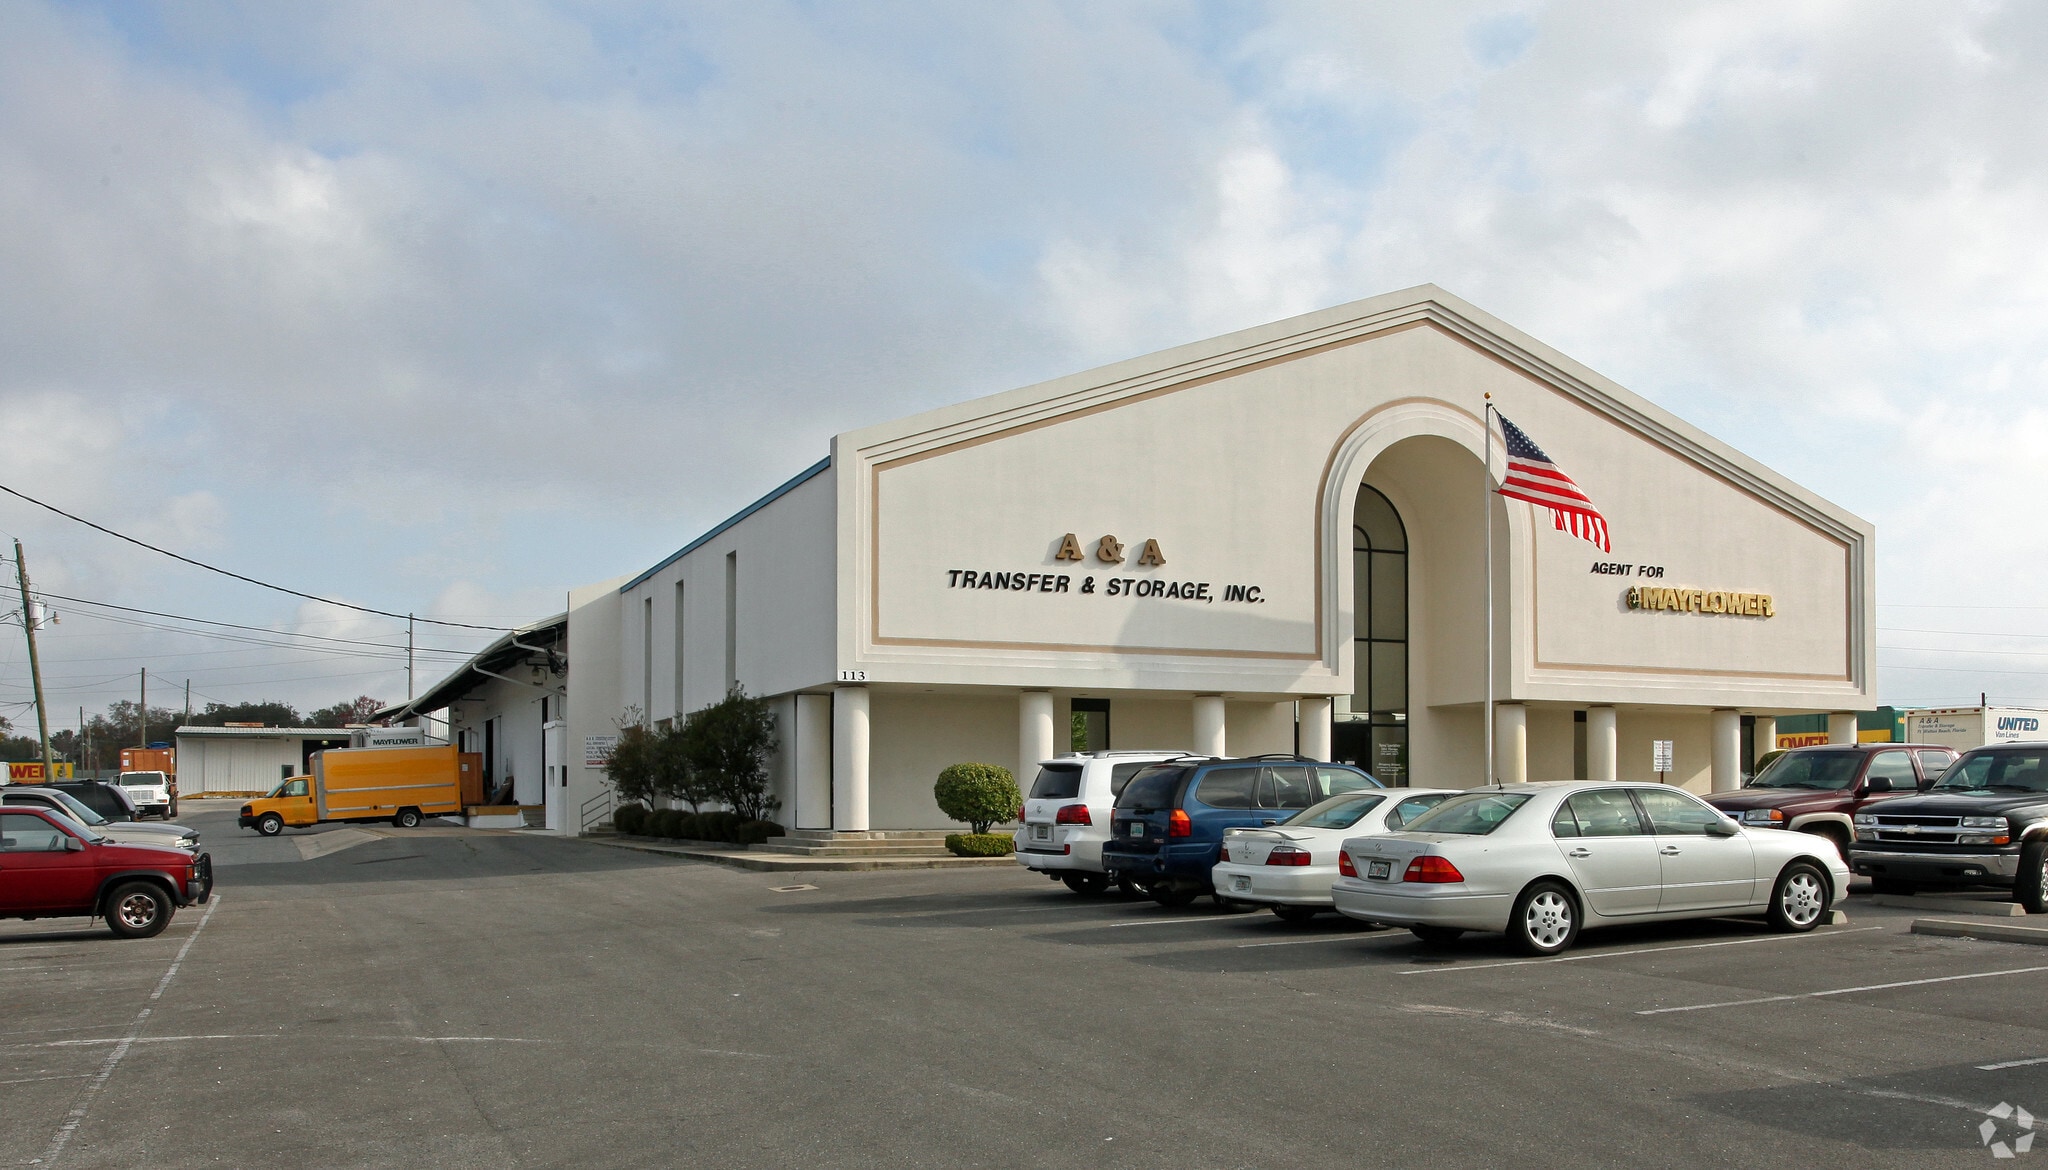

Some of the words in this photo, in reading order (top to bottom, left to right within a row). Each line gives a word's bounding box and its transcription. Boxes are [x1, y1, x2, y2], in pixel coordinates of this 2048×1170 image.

[1055, 533, 1084, 560] A
[1097, 534, 1125, 563] &
[1138, 538, 1166, 565] A
[1590, 562, 1633, 576] AGENT
[1639, 565, 1664, 578] FOR
[949, 569, 1070, 593] TRANSFER
[1081, 576, 1095, 594] &
[1107, 578, 1213, 603] STORAGE,
[1224, 584, 1265, 603] INC.
[1641, 587, 1773, 617] MAYFLOWER
[842, 671, 865, 680] 113
[1998, 717, 2038, 731] UNITED
[373, 738, 418, 746] MAYFLOWER
